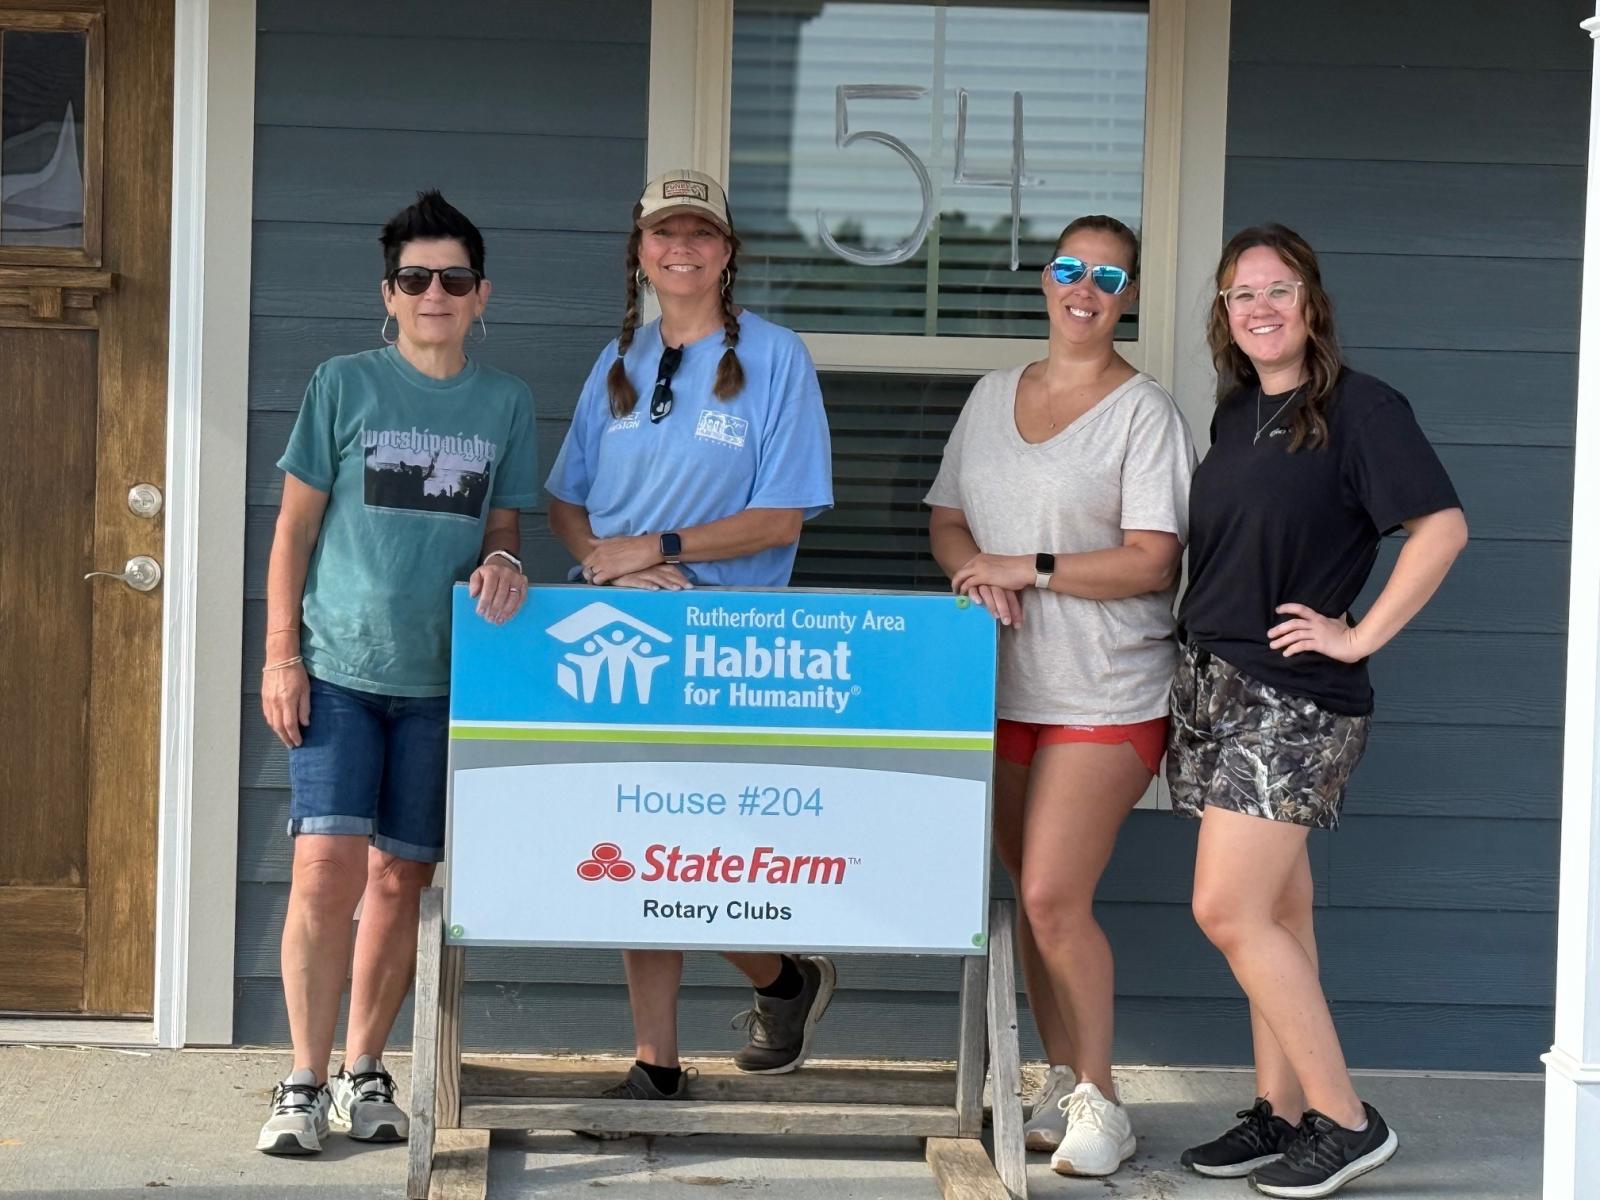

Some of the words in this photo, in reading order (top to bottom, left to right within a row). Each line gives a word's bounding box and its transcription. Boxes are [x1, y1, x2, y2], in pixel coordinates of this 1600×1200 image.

[816, 83, 1046, 271] 54
[685, 606, 786, 631] Rutherford
[791, 608, 857, 633] County
[862, 610, 905, 631] Area
[684, 634, 852, 680] Habitat
[684, 682, 721, 706] for
[616, 783, 727, 814] House
[738, 785, 824, 817] #204
[643, 899, 719, 924] Rotary
[726, 901, 793, 921] Clubs
